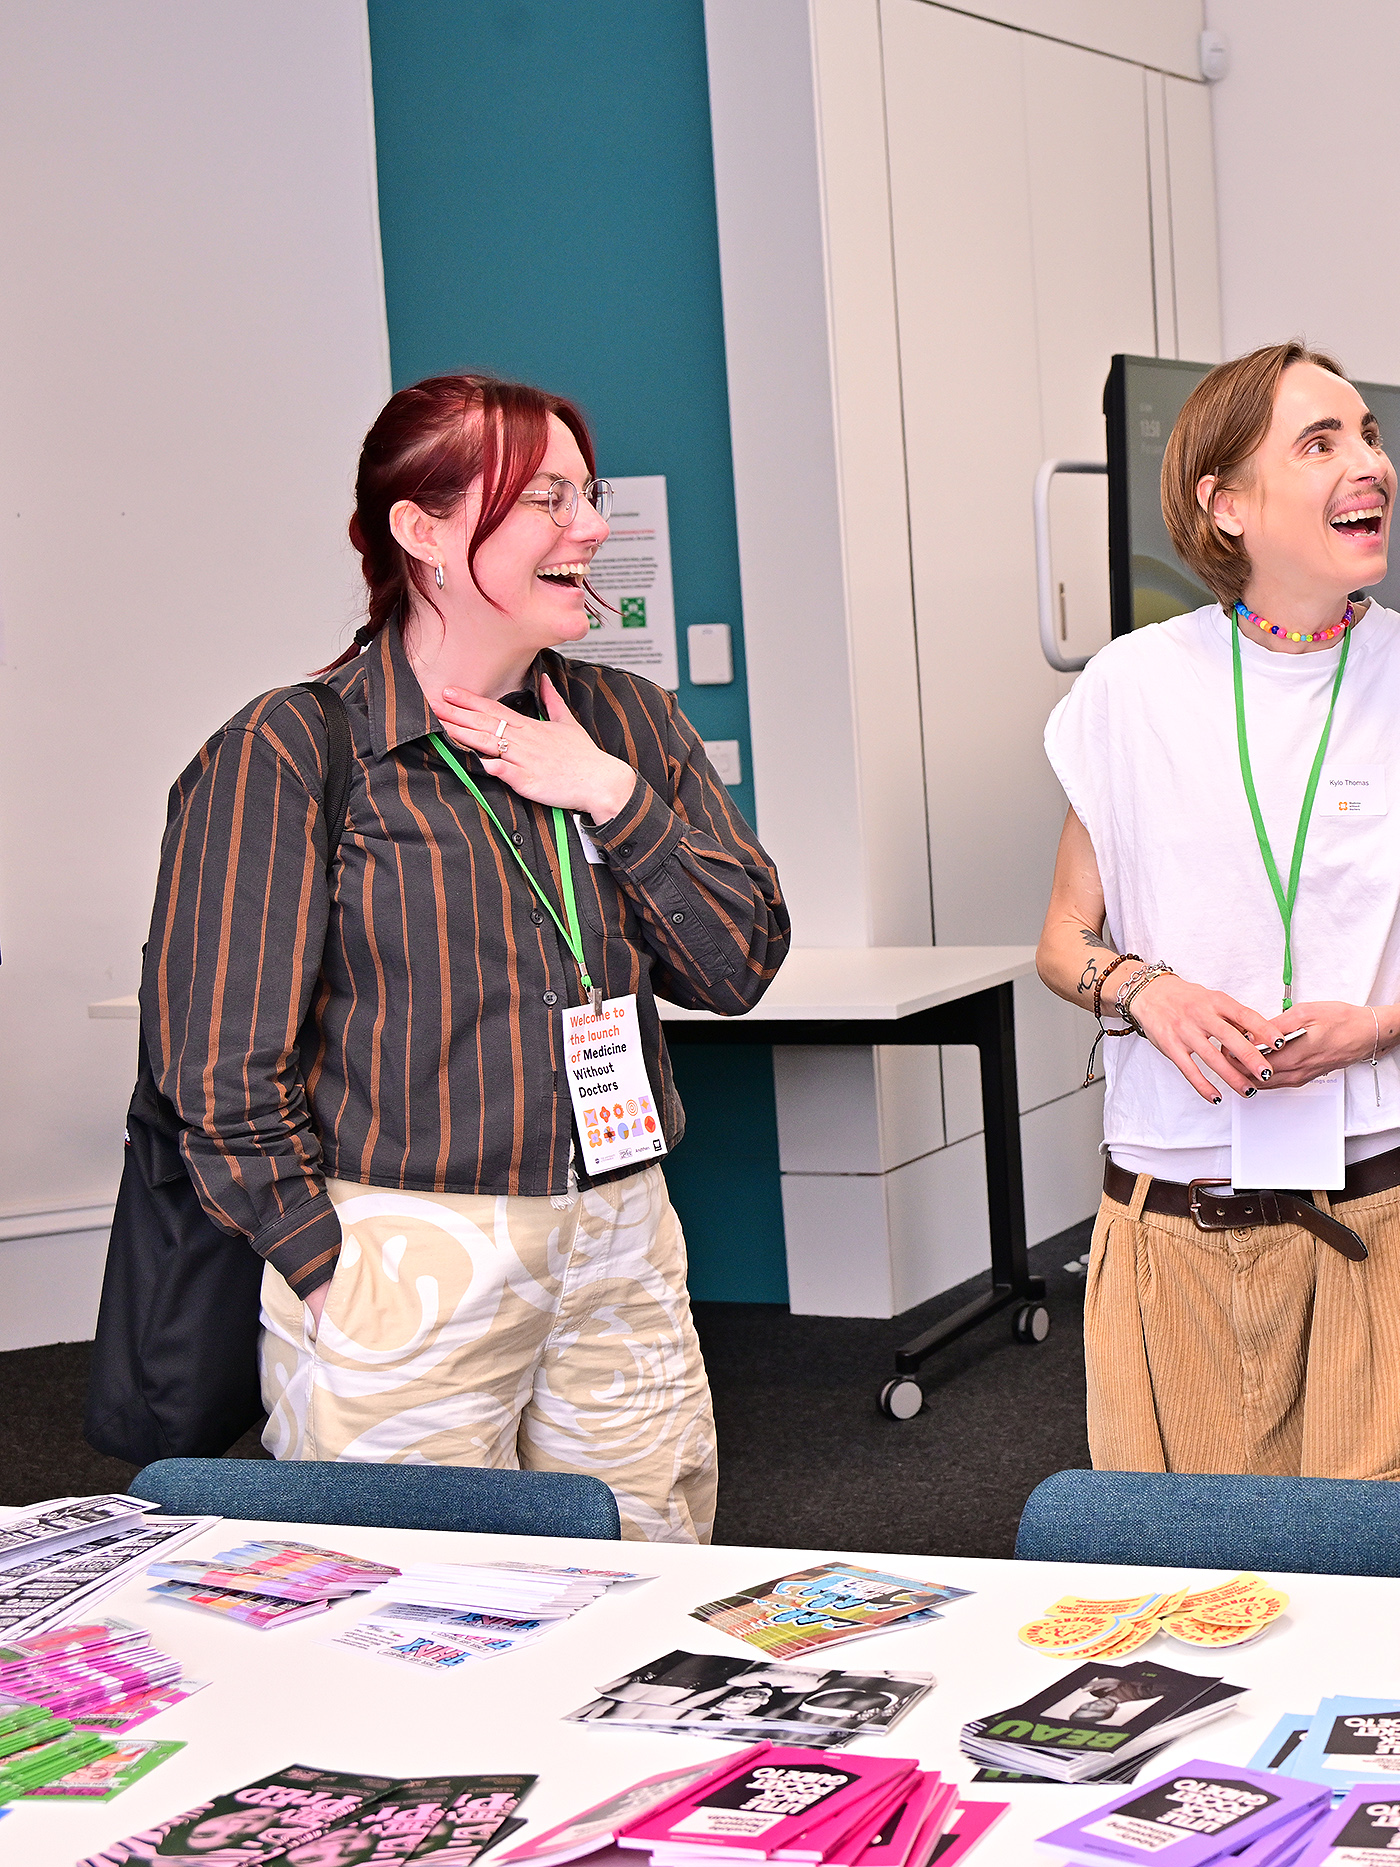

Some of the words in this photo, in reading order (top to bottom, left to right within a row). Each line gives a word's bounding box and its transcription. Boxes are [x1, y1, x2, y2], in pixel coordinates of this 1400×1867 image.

[1345, 779, 1369, 787] Thomas
[570, 1011, 611, 1028] Welcome
[613, 1007, 625, 1019] to
[570, 1033, 586, 1046] the
[588, 1025, 620, 1042] launch
[571, 1050, 581, 1064] of
[583, 1043, 627, 1061] Medicine
[573, 1062, 615, 1081] Without
[578, 1082, 619, 1099] Doctors
[1344, 1717, 1379, 1728] TO
[986, 1720, 1131, 1749] BEAU
[752, 1767, 786, 1780] TO
[784, 1770, 848, 1786] GUIDE
[745, 1777, 836, 1796] POCKET
[1173, 1779, 1208, 1795] TO
[1202, 1784, 1268, 1806] GUIDE
[234, 1785, 364, 1813] PrEP
[739, 1799, 806, 1815] LITTLE
[752, 1790, 821, 1805] BACK
[1165, 1790, 1255, 1816] POCKET
[1171, 1803, 1239, 1825] BACK
[1156, 1814, 1223, 1834] LITTLE
